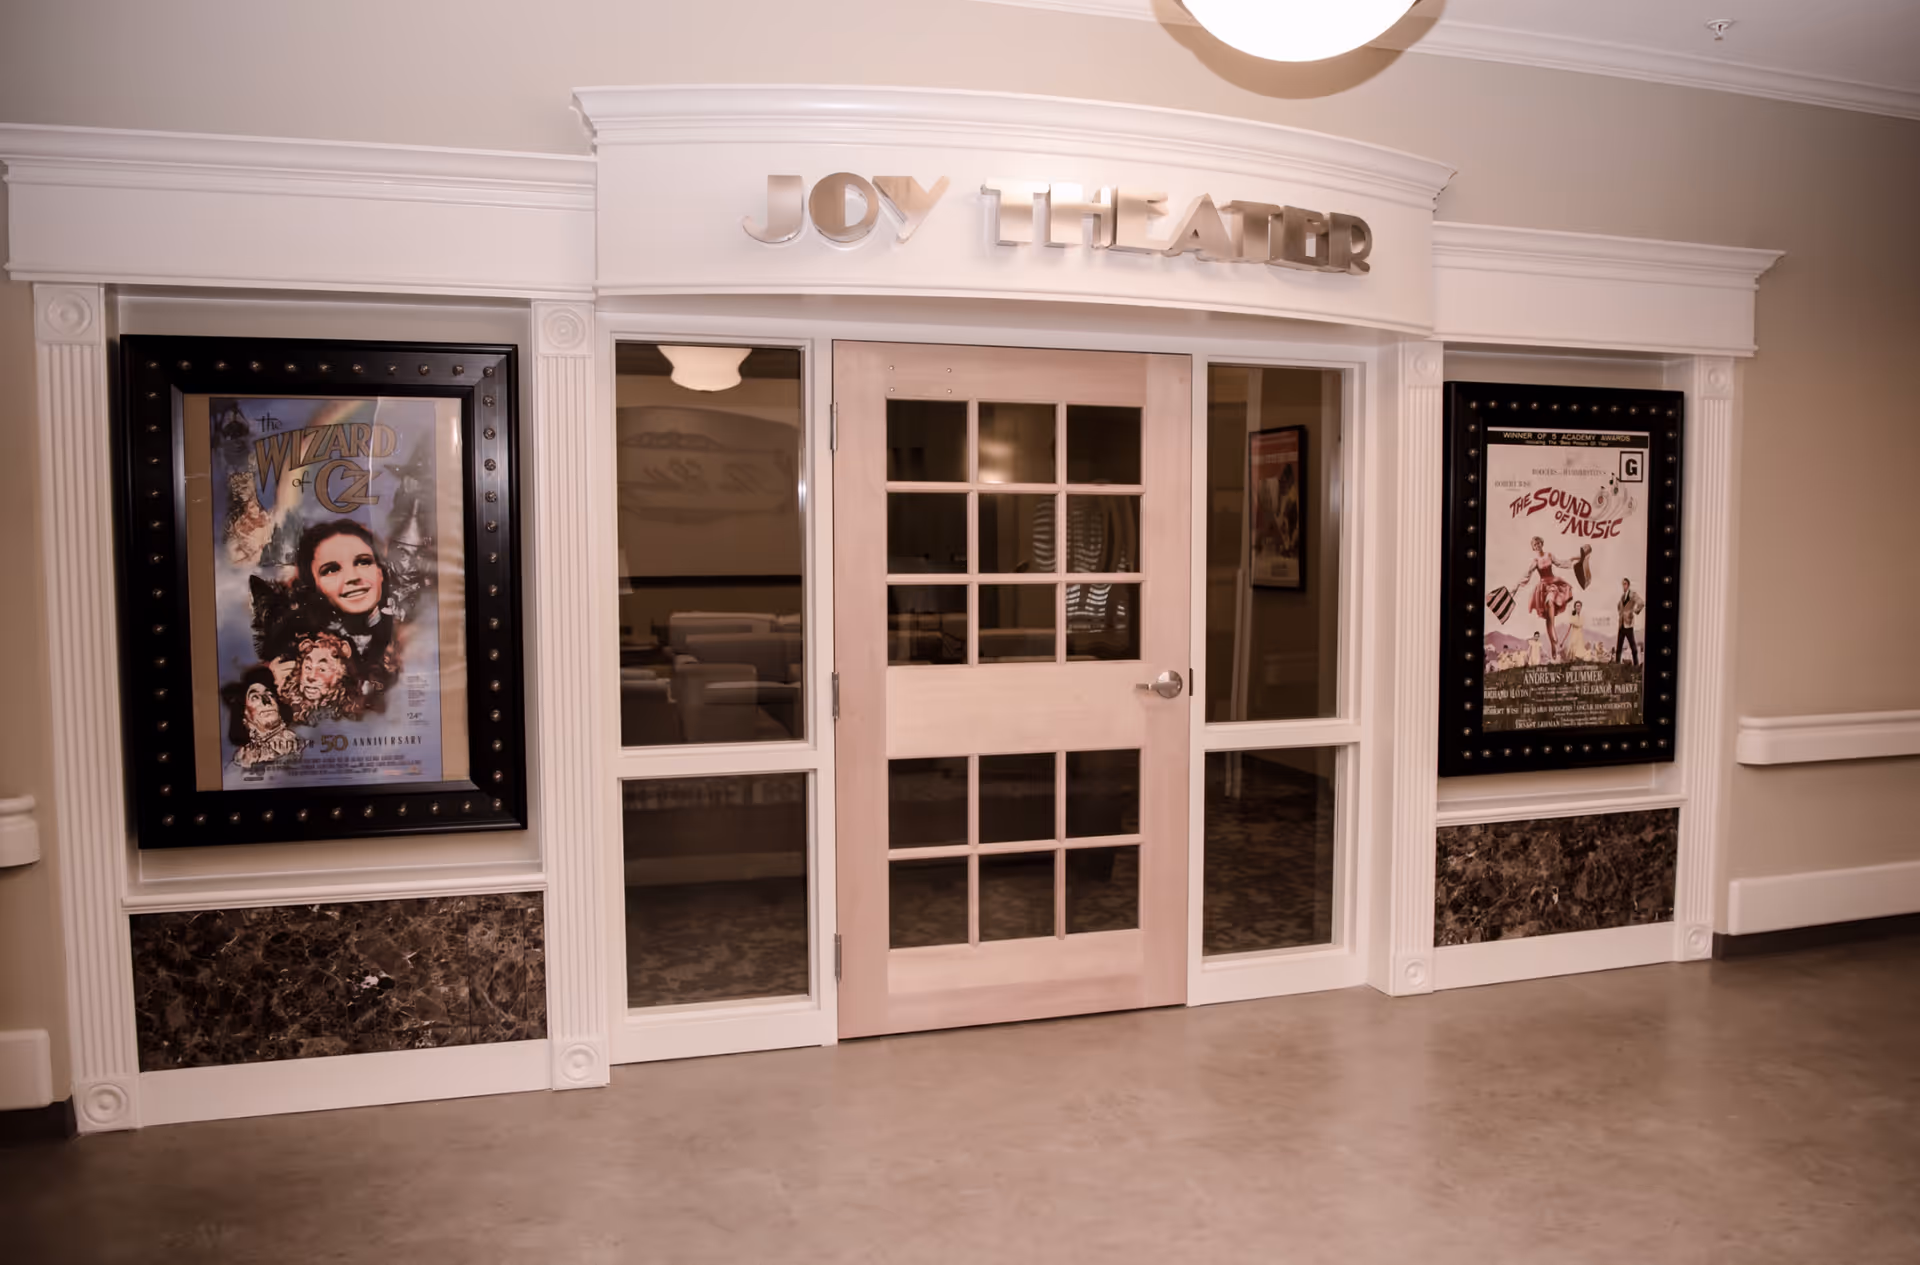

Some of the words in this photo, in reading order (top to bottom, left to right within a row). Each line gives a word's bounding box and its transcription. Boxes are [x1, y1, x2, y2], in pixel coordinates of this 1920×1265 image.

[742, 172, 950, 244] JOY
[980, 177, 1373, 276] THEATER
[255, 412, 282, 432] the
[1503, 432, 1533, 440] WINNER
[255, 423, 397, 495] WIZARD
[1625, 458, 1638, 476] G
[292, 471, 312, 494] of
[1509, 493, 1532, 519] THE
[1526, 487, 1592, 518] SOUND
[1555, 510, 1570, 523] OF
[1523, 672, 1561, 685] ANDREWS
[1565, 670, 1603, 683] PLUMMER
[320, 734, 349, 753] 50
[352, 735, 423, 748] ANNIVERSARY
